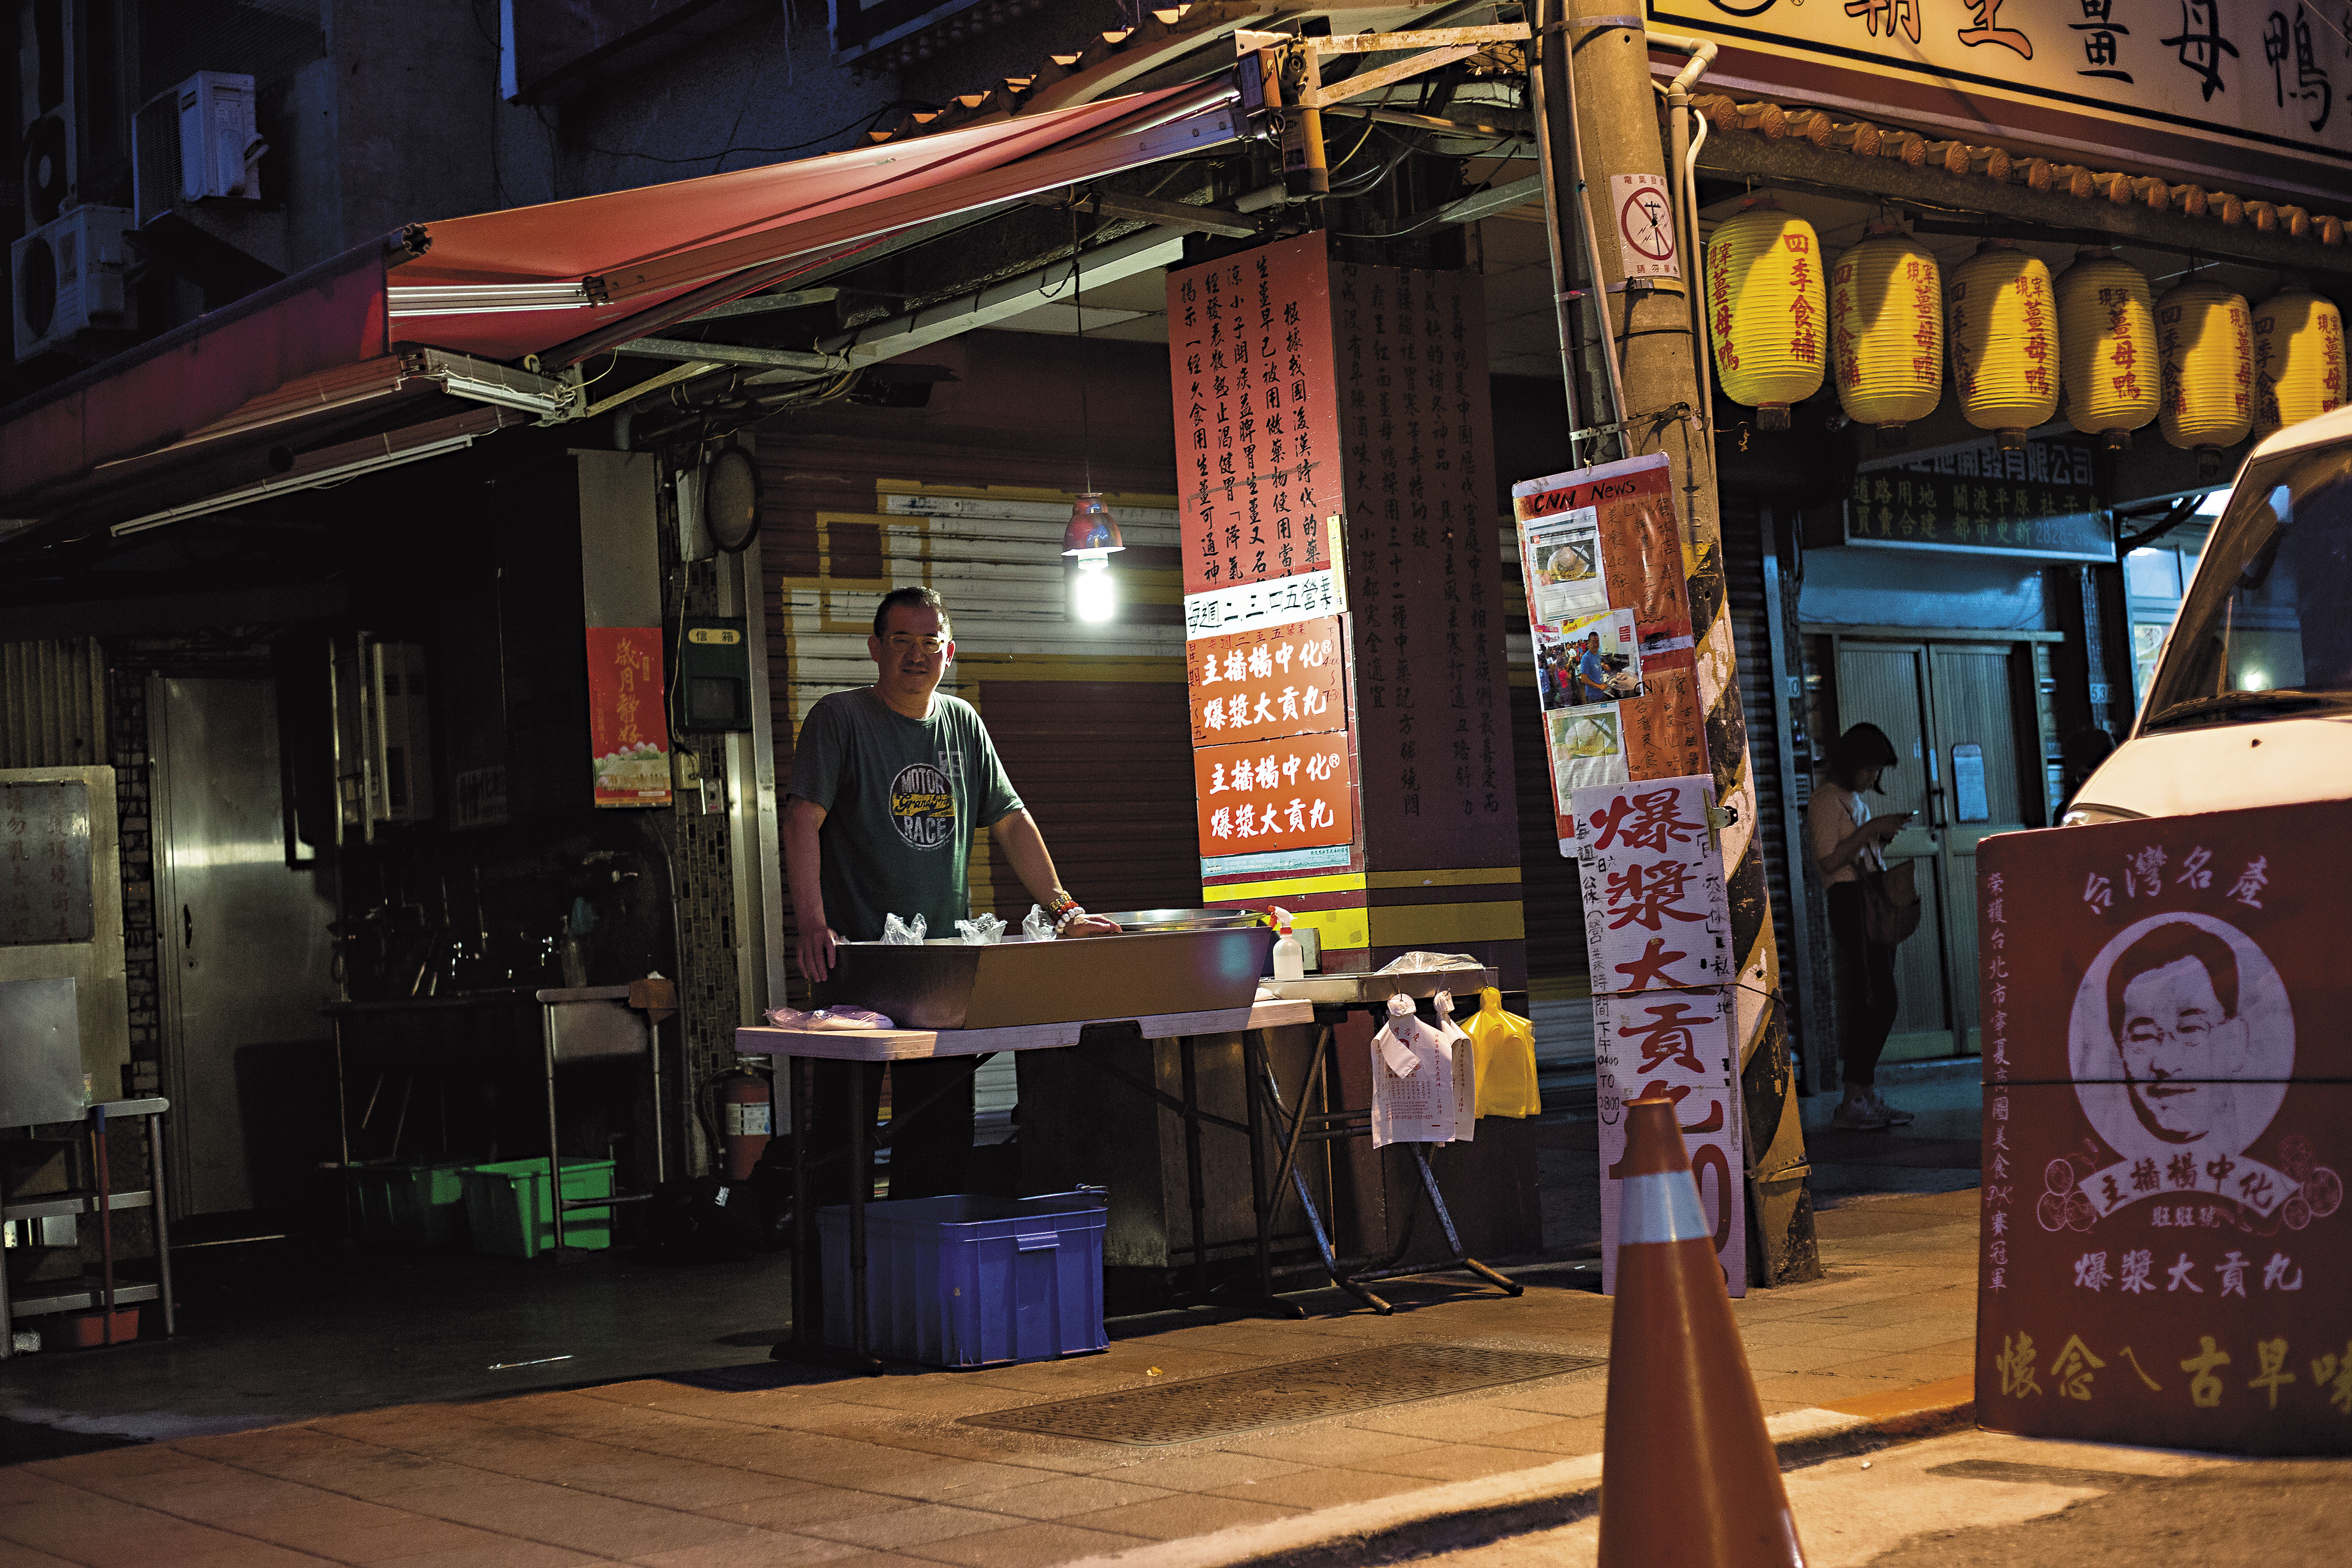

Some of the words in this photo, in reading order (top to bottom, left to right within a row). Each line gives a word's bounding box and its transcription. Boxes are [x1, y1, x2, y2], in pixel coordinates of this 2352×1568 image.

[1783, 234, 1815, 363] 四季食補
[2108, 307, 2141, 401] 薑母鴨
[1256, 255, 1294, 579] 生薑早已被用做藥物使用當
[1283, 301, 1321, 572] 根據我國後漢時代的藥
[1535, 490, 1576, 512] CNN
[1591, 480, 1636, 501] News
[695, 630, 733, 642] 信箱
[1204, 685, 1327, 731] 爆漿大貢丸
[1634, 677, 1664, 697] CNN
[901, 768, 946, 794] MOTOR
[904, 816, 947, 843] RACE
[1211, 799, 1334, 840] 爆漿大貢丸
[2083, 844, 2269, 915] 台灣名產
[2102, 1152, 2273, 1212] 主播楊中化
[2074, 1248, 2303, 1298] 爆漿大貢丸
